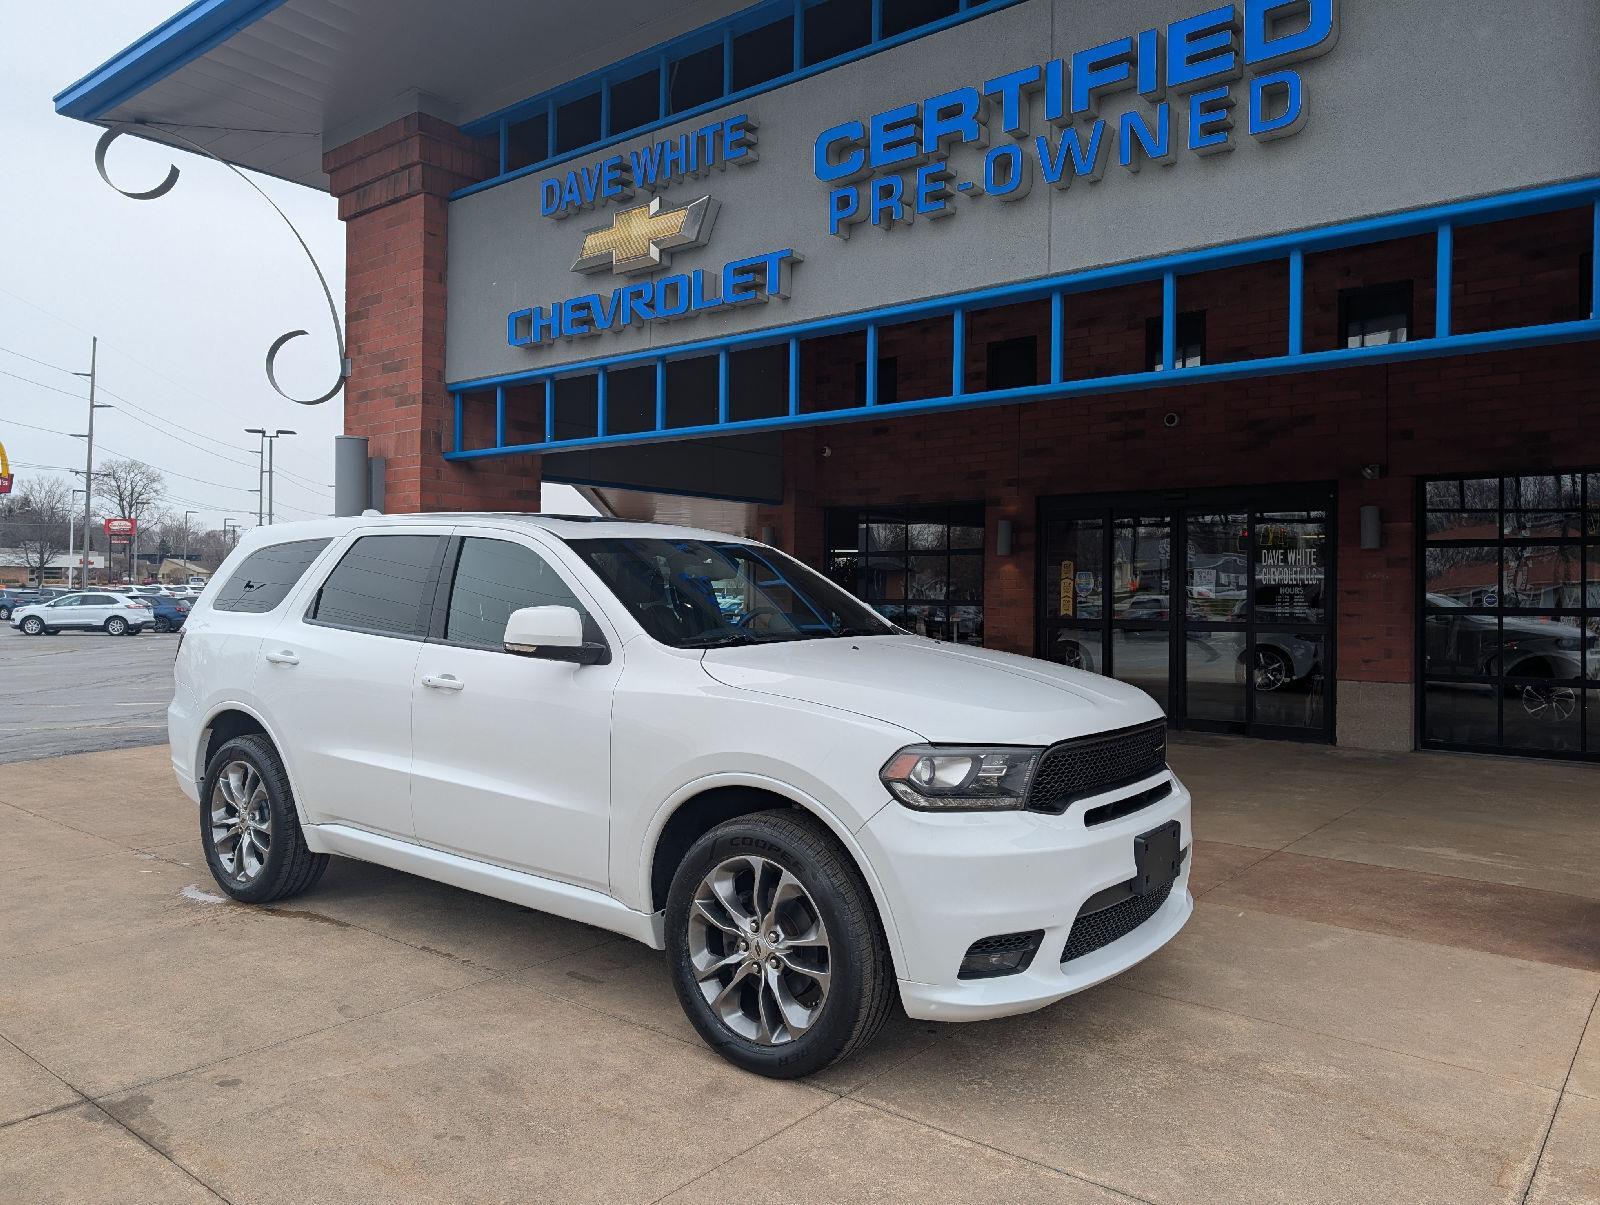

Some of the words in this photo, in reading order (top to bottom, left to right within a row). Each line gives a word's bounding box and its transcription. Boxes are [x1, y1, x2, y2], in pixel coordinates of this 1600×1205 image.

[814, 0, 1333, 182] CERTIFIED
[540, 156, 623, 217] DAVE
[629, 114, 748, 188] WHITE
[828, 71, 1303, 235] PRE-OWNED
[507, 248, 793, 346] CHEVROLET
[1262, 549, 1285, 565] DAVE
[1288, 548, 1317, 565] WHITE
[1279, 586, 1304, 595] HOURS
